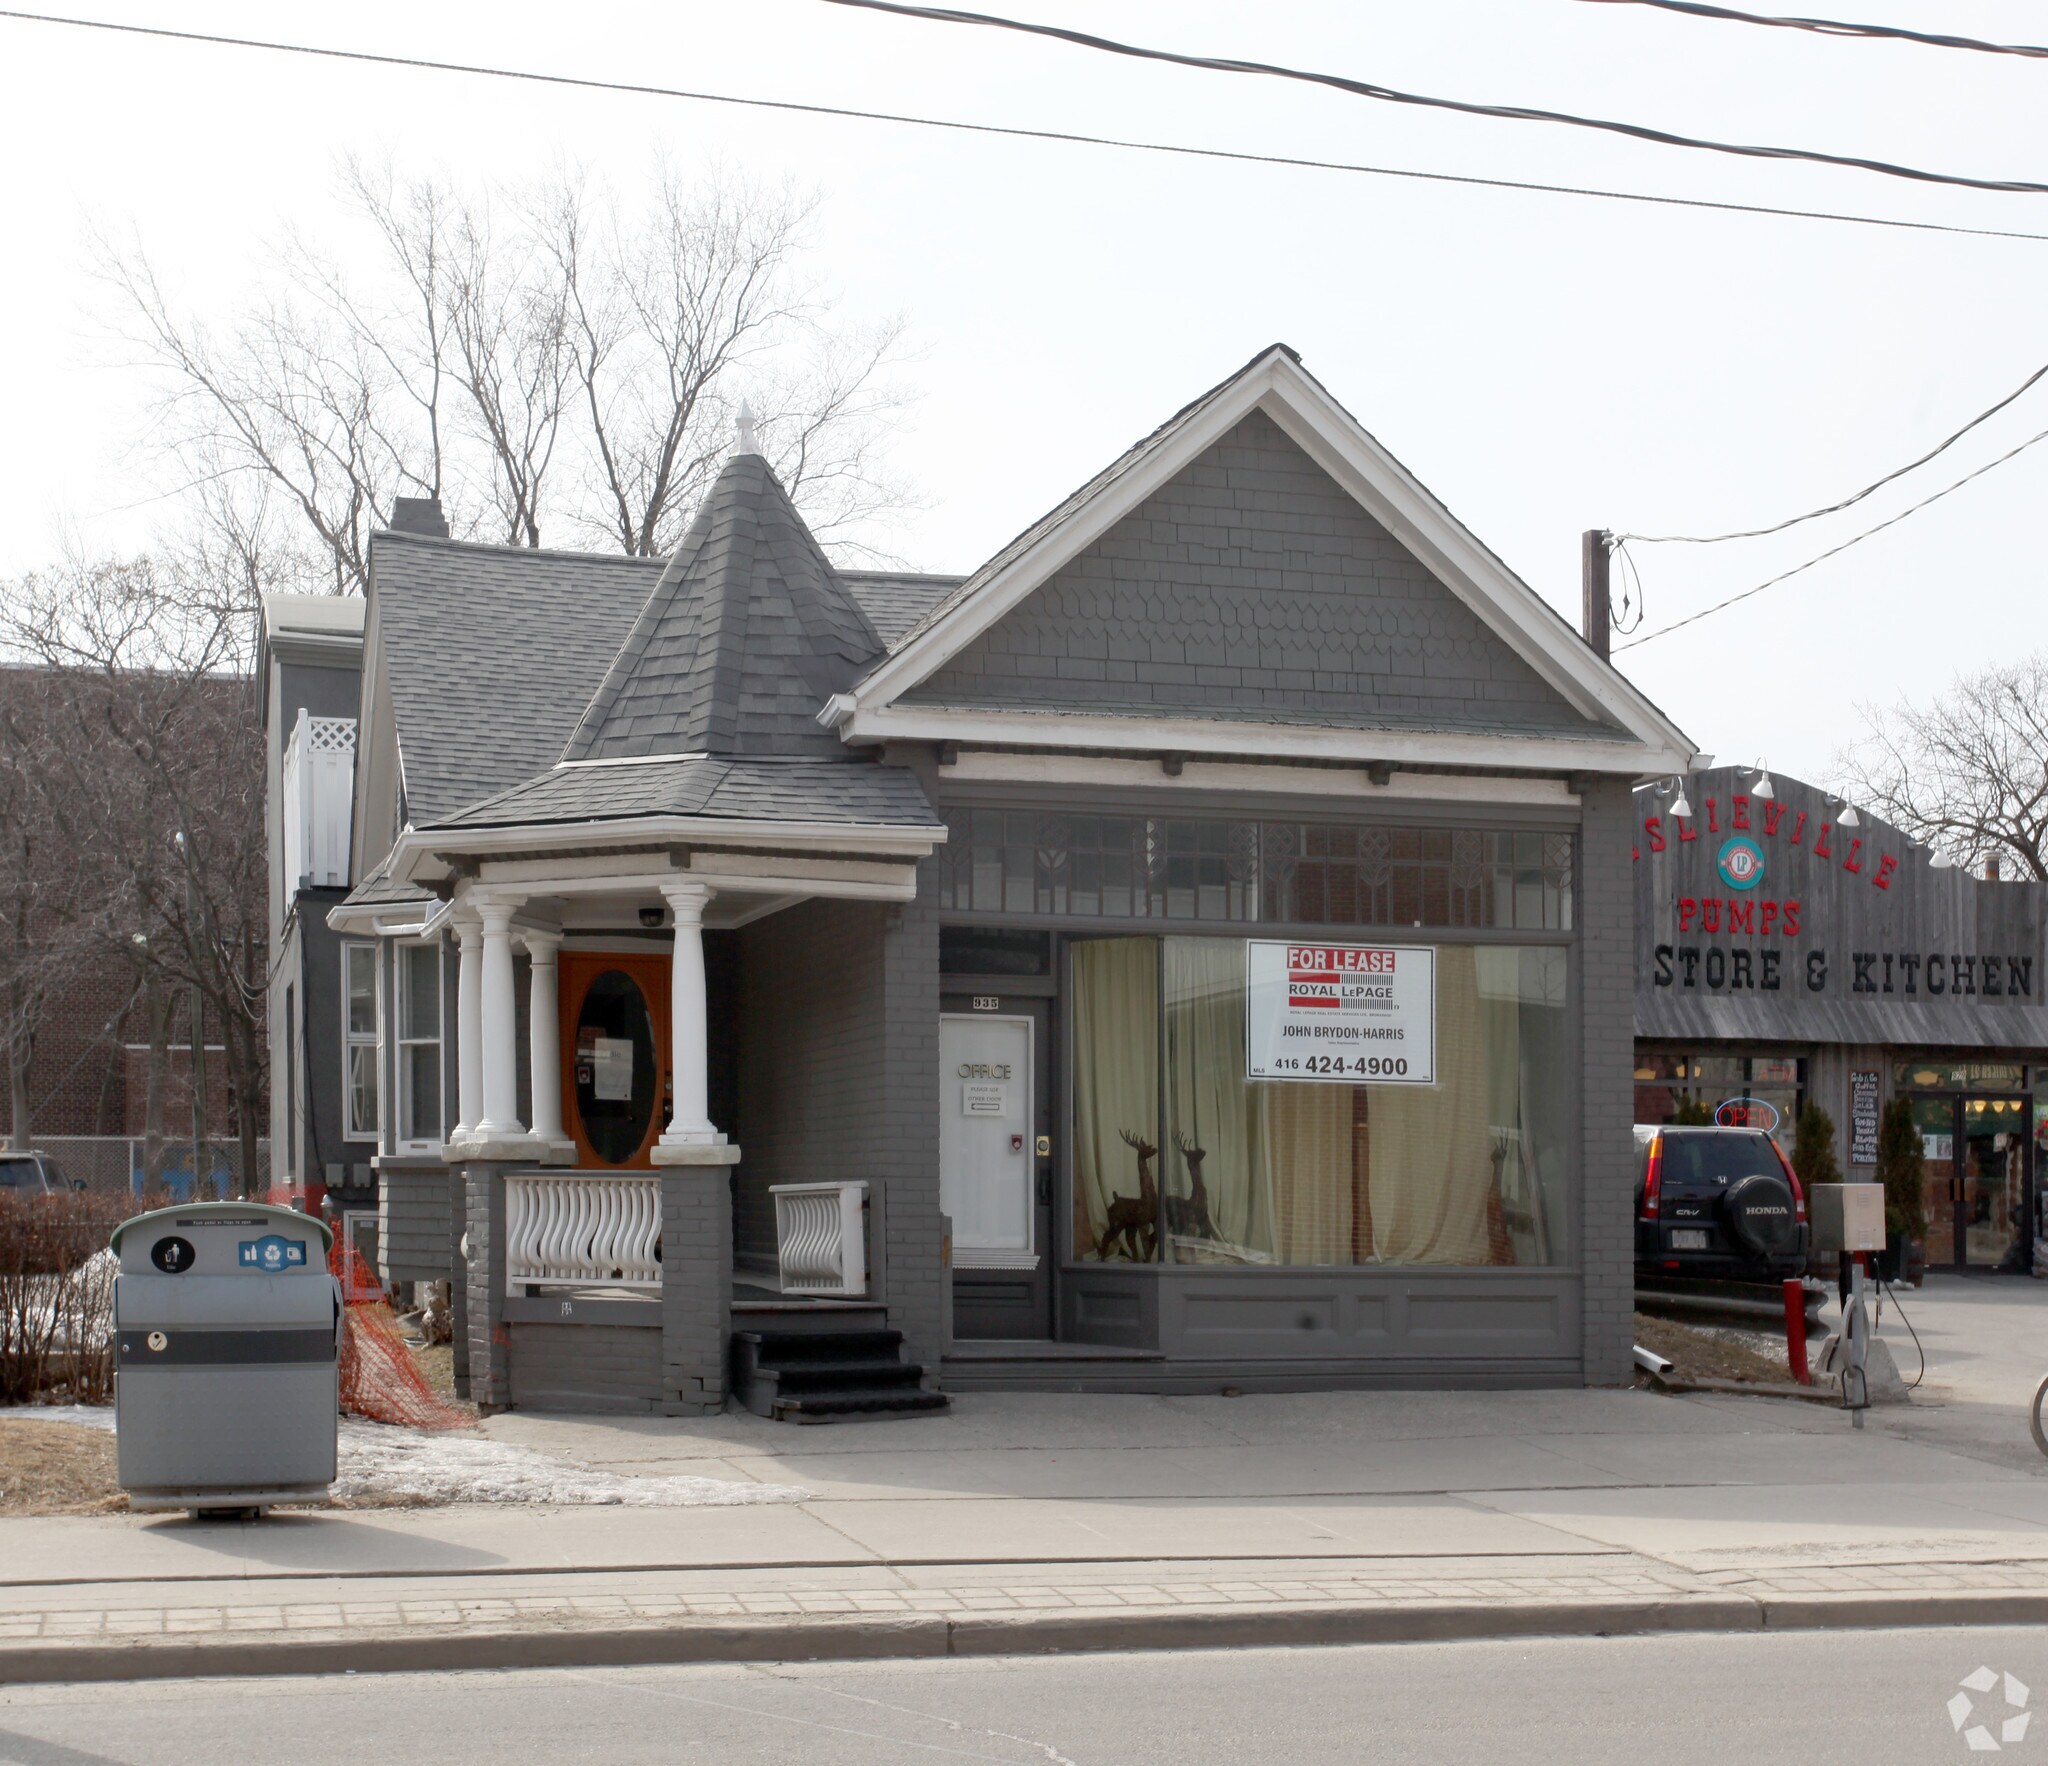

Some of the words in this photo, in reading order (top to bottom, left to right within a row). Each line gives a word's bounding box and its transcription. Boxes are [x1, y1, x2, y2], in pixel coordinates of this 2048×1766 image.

[1632, 795, 1898, 890] SLIEVILLE
[1679, 897, 1801, 936] PUMPS
[1288, 949, 1326, 969] FOR
[1333, 951, 1394, 972] LEASE
[1654, 943, 1781, 990] STORE
[1806, 948, 1829, 992] &
[1852, 952, 2033, 996] KITCHEN
[1289, 984, 1337, 996] ROYAL
[974, 998, 998, 1008] 935
[1282, 1025, 1311, 1037] JOHN
[1314, 1026, 1404, 1040] BRYDON-HARRIS
[957, 1063, 1012, 1080] OFFICE
[1275, 1058, 1299, 1070] 416
[1305, 1056, 1408, 1075] 424-4900
[1759, 1066, 1796, 1082] ATM
[1718, 1106, 1772, 1128] OPEN
[1745, 1206, 1788, 1215] HONDA
